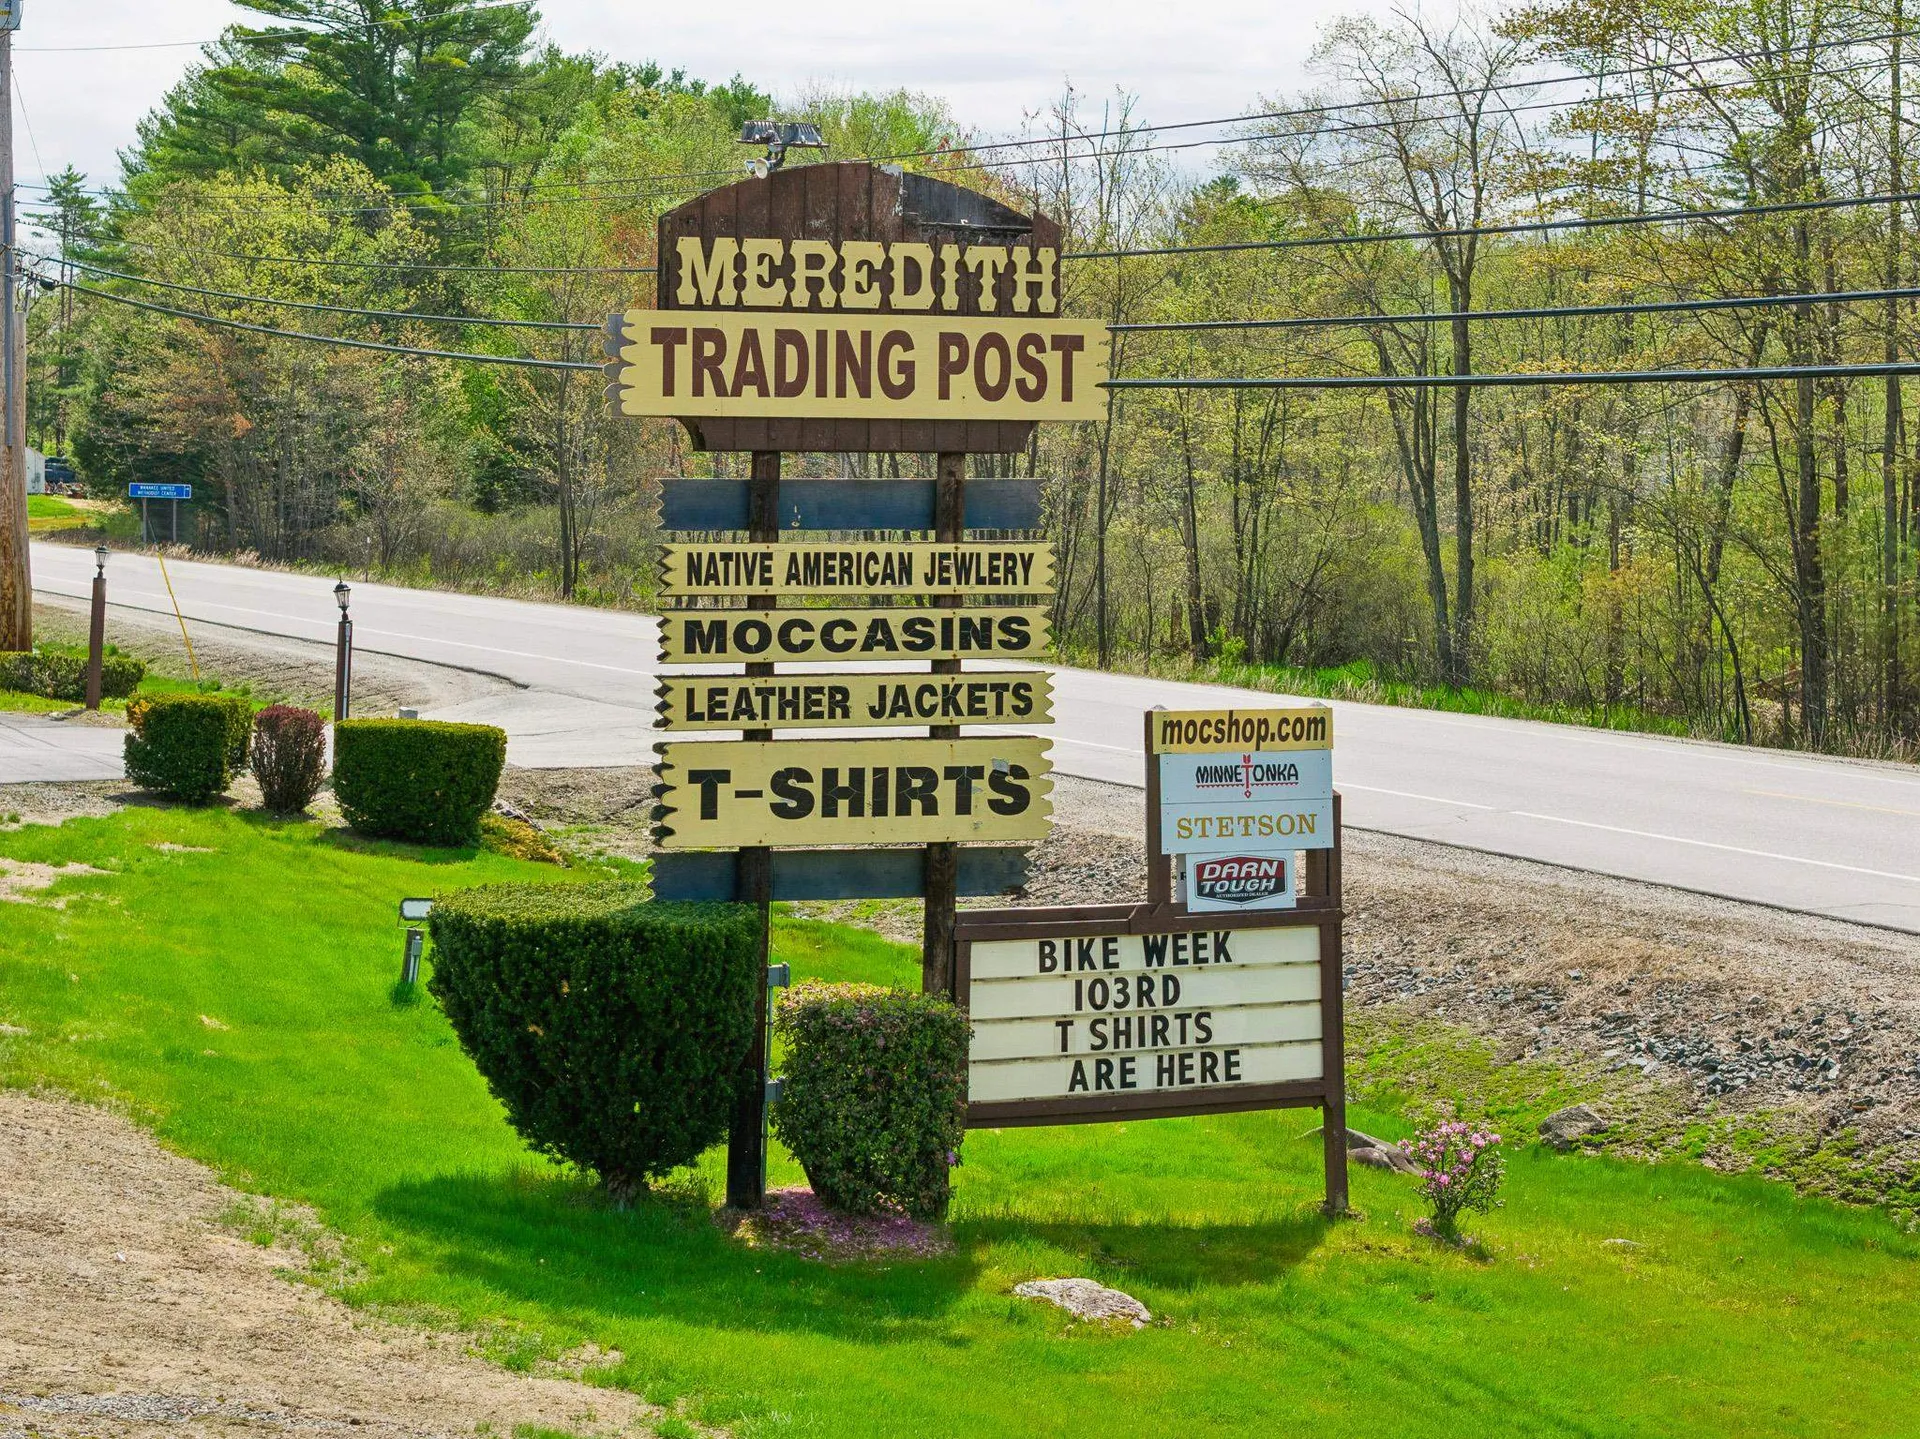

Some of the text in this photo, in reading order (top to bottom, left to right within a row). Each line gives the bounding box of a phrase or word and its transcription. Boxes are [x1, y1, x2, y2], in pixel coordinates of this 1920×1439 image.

[676, 236, 1057, 313] MEREDITH
[650, 327, 1085, 402] TRADING POST
[687, 551, 1034, 586] NATIVE AMERICAN JEWLERY
[684, 616, 1031, 654] MOCCASINS
[685, 682, 1033, 722] LEATHER JACKETS
[1161, 710, 1326, 751] mocshop.com
[688, 764, 1031, 820] T-SHIRTS
[1195, 762, 1299, 787] MINNETONKA
[1176, 813, 1318, 839] STETSON
[1200, 877, 1276, 894] TOUGH
[1202, 860, 1278, 879] DARN
[1039, 931, 1233, 973] BIKE WEEK
[1074, 974, 1181, 1012] 103RD
[1055, 1012, 1213, 1053] T SHIRTS
[1068, 1049, 1242, 1093] ARE HERE
